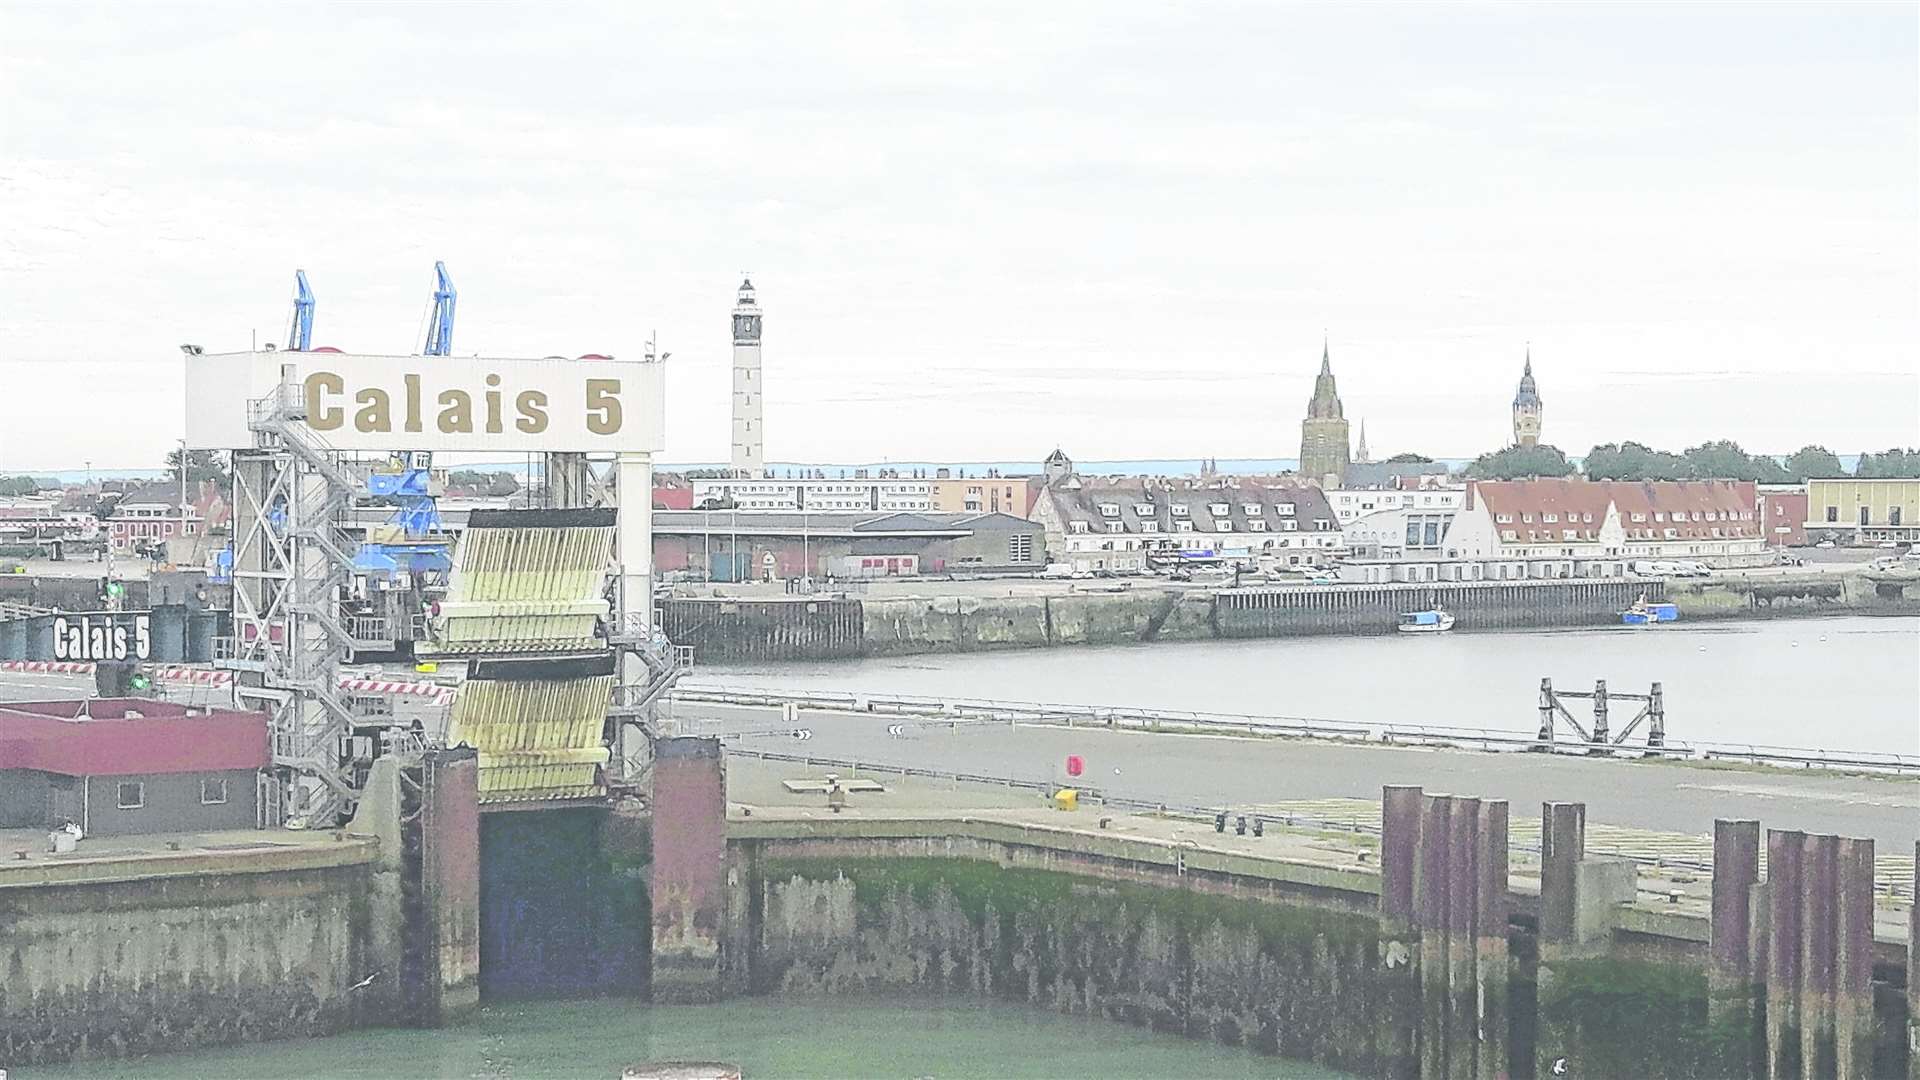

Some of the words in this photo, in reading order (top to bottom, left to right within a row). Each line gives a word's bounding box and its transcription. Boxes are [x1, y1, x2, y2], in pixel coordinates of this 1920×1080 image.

[304, 372, 549, 434] Calais
[586, 379, 622, 435] 5
[54, 616, 127, 660] Calais
[135, 615, 150, 659] 5
